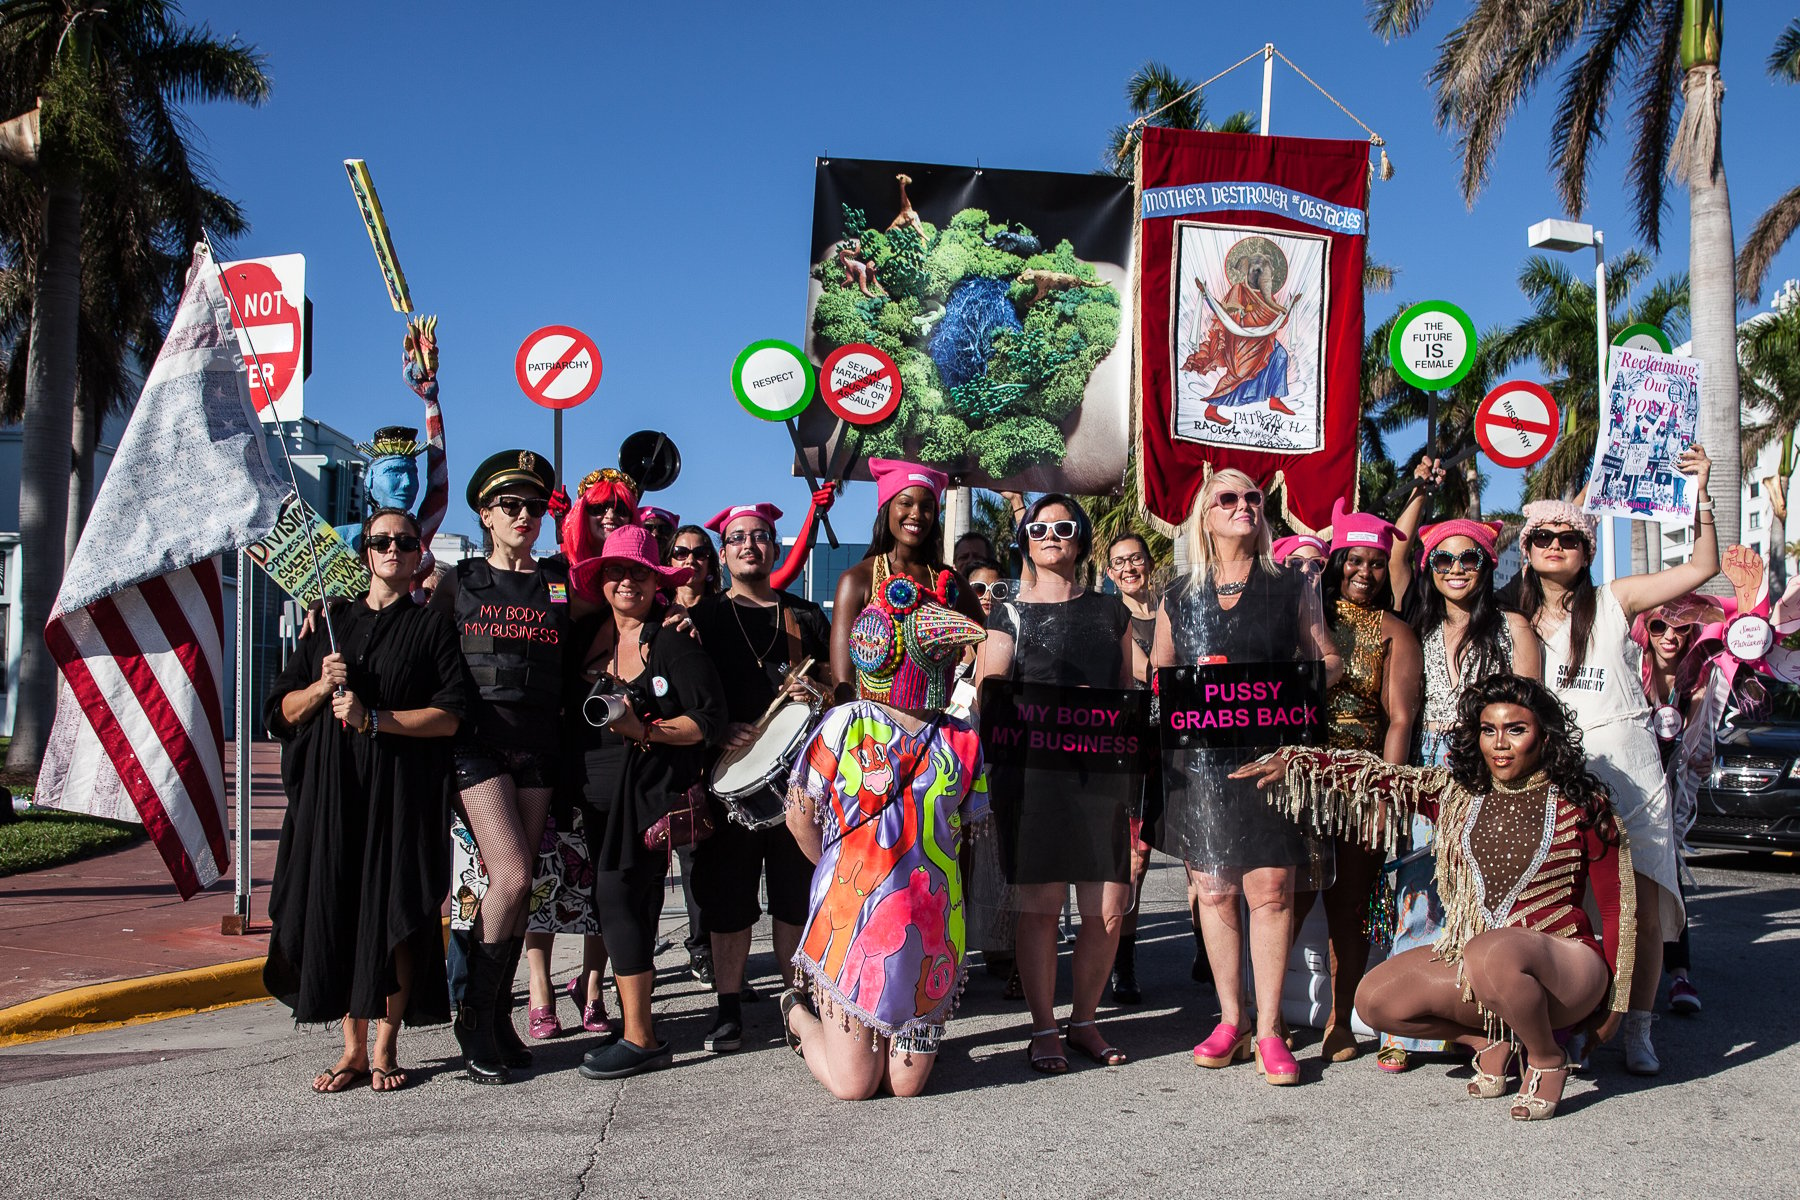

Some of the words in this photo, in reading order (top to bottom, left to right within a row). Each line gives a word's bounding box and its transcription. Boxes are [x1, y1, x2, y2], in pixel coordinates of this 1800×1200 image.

[1144, 186, 1207, 213] MOTHER
[1211, 186, 1289, 211] DESTROYER
[244, 291, 283, 318] NOT
[1424, 322, 1443, 330] THE
[1413, 333, 1452, 342] FUTURE
[1426, 343, 1443, 358] IS
[528, 361, 589, 372] PATRIARCHY
[847, 361, 882, 379] SEXUAL
[1415, 360, 1453, 368] FEMALE
[1621, 351, 1695, 381] Reclaiming
[752, 371, 795, 389] RESPECT
[835, 378, 866, 395] ABUSE
[870, 391, 885, 401] OR
[1644, 377, 1668, 392] Our
[837, 388, 877, 409] ASSAULT
[1626, 398, 1685, 419] POWER!
[1502, 401, 1531, 448] MISOGYNY
[245, 503, 316, 566] DIVISION
[278, 532, 332, 579] CULTURAL
[284, 537, 337, 589] OBSESSION
[480, 605, 502, 618] MY
[506, 606, 546, 622] BODY
[464, 623, 488, 636] MY
[490, 623, 558, 644] BUSINESS
[1558, 664, 1587, 677] SMSH
[1590, 667, 1605, 679] THE
[1205, 681, 1283, 702] PUSSY
[1017, 703, 1050, 723] MY
[1057, 706, 1120, 729] BODY
[1170, 708, 1250, 730] GRABS
[1257, 706, 1318, 727] BACK
[992, 726, 1023, 746] MY
[1030, 731, 1139, 754] BUSINESS
